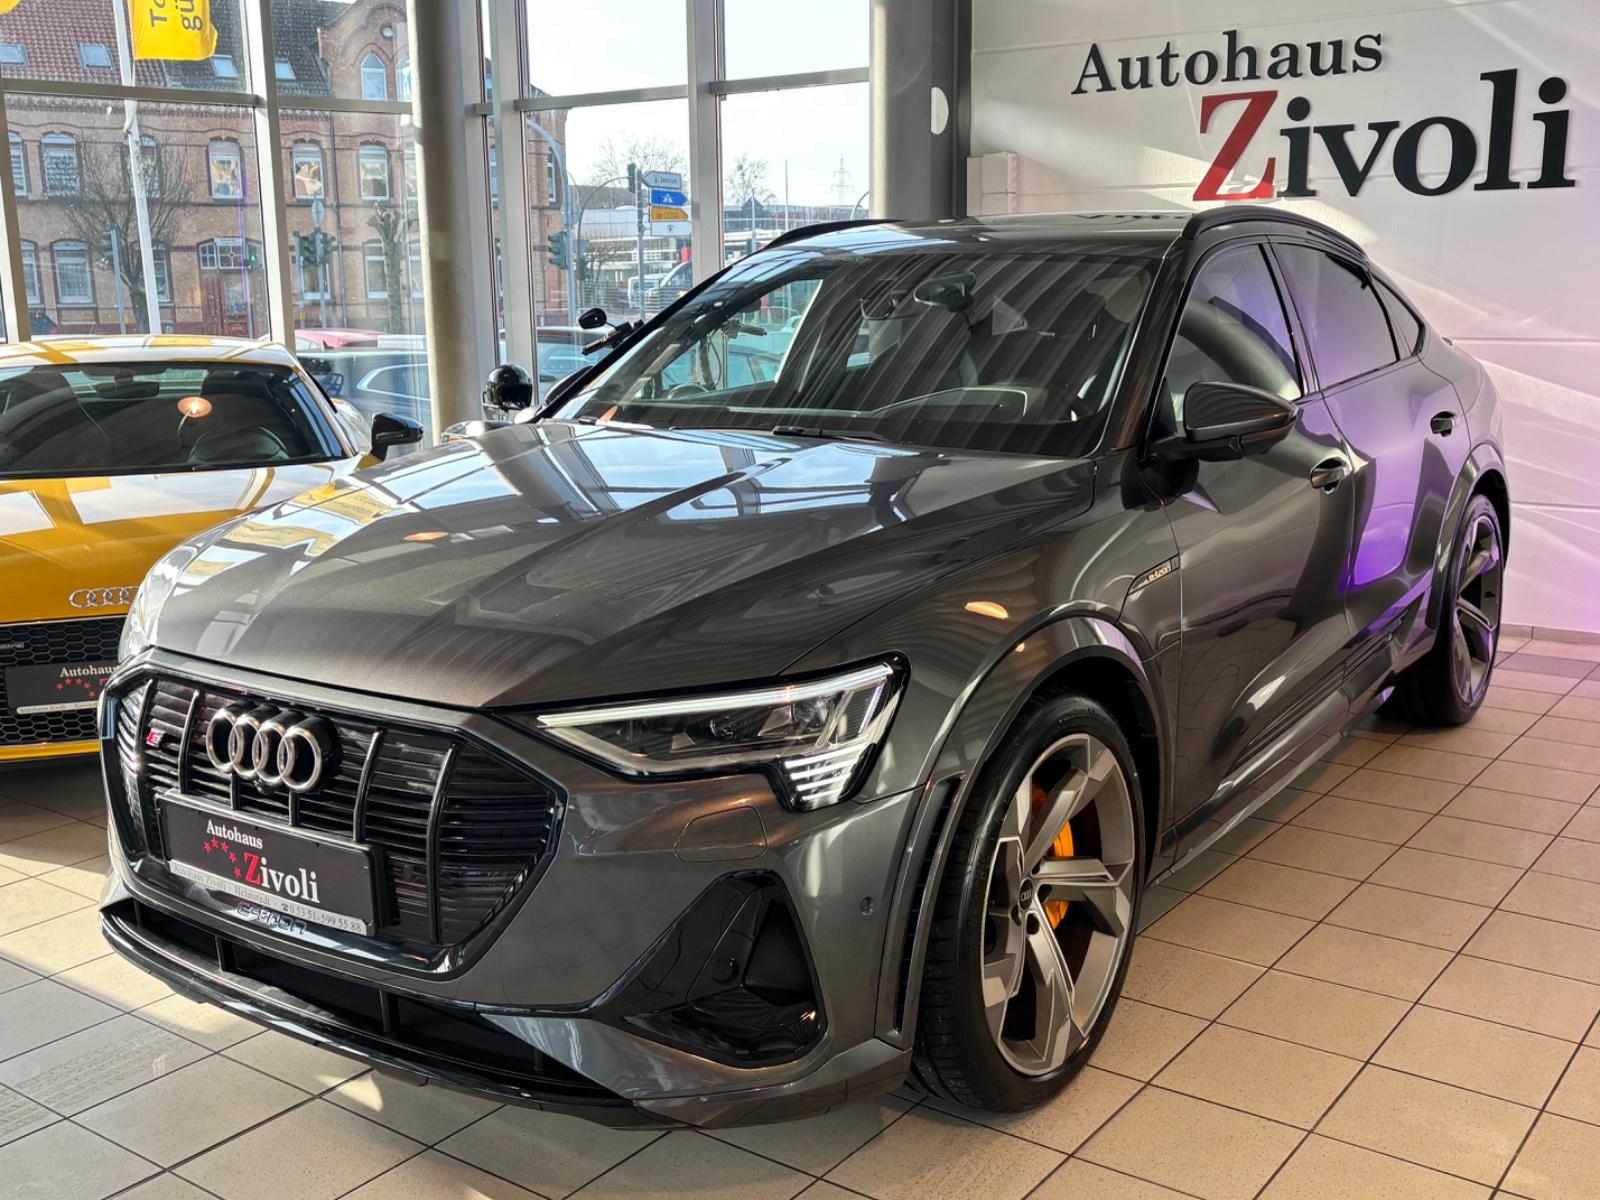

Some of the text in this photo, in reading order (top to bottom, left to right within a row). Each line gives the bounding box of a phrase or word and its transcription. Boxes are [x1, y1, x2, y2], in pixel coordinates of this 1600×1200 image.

[1071, 29, 1383, 95] Autohaus
[1192, 68, 1576, 202] Zivoli
[206, 819, 263, 850] Autohaus
[243, 852, 320, 904] Zivoli
